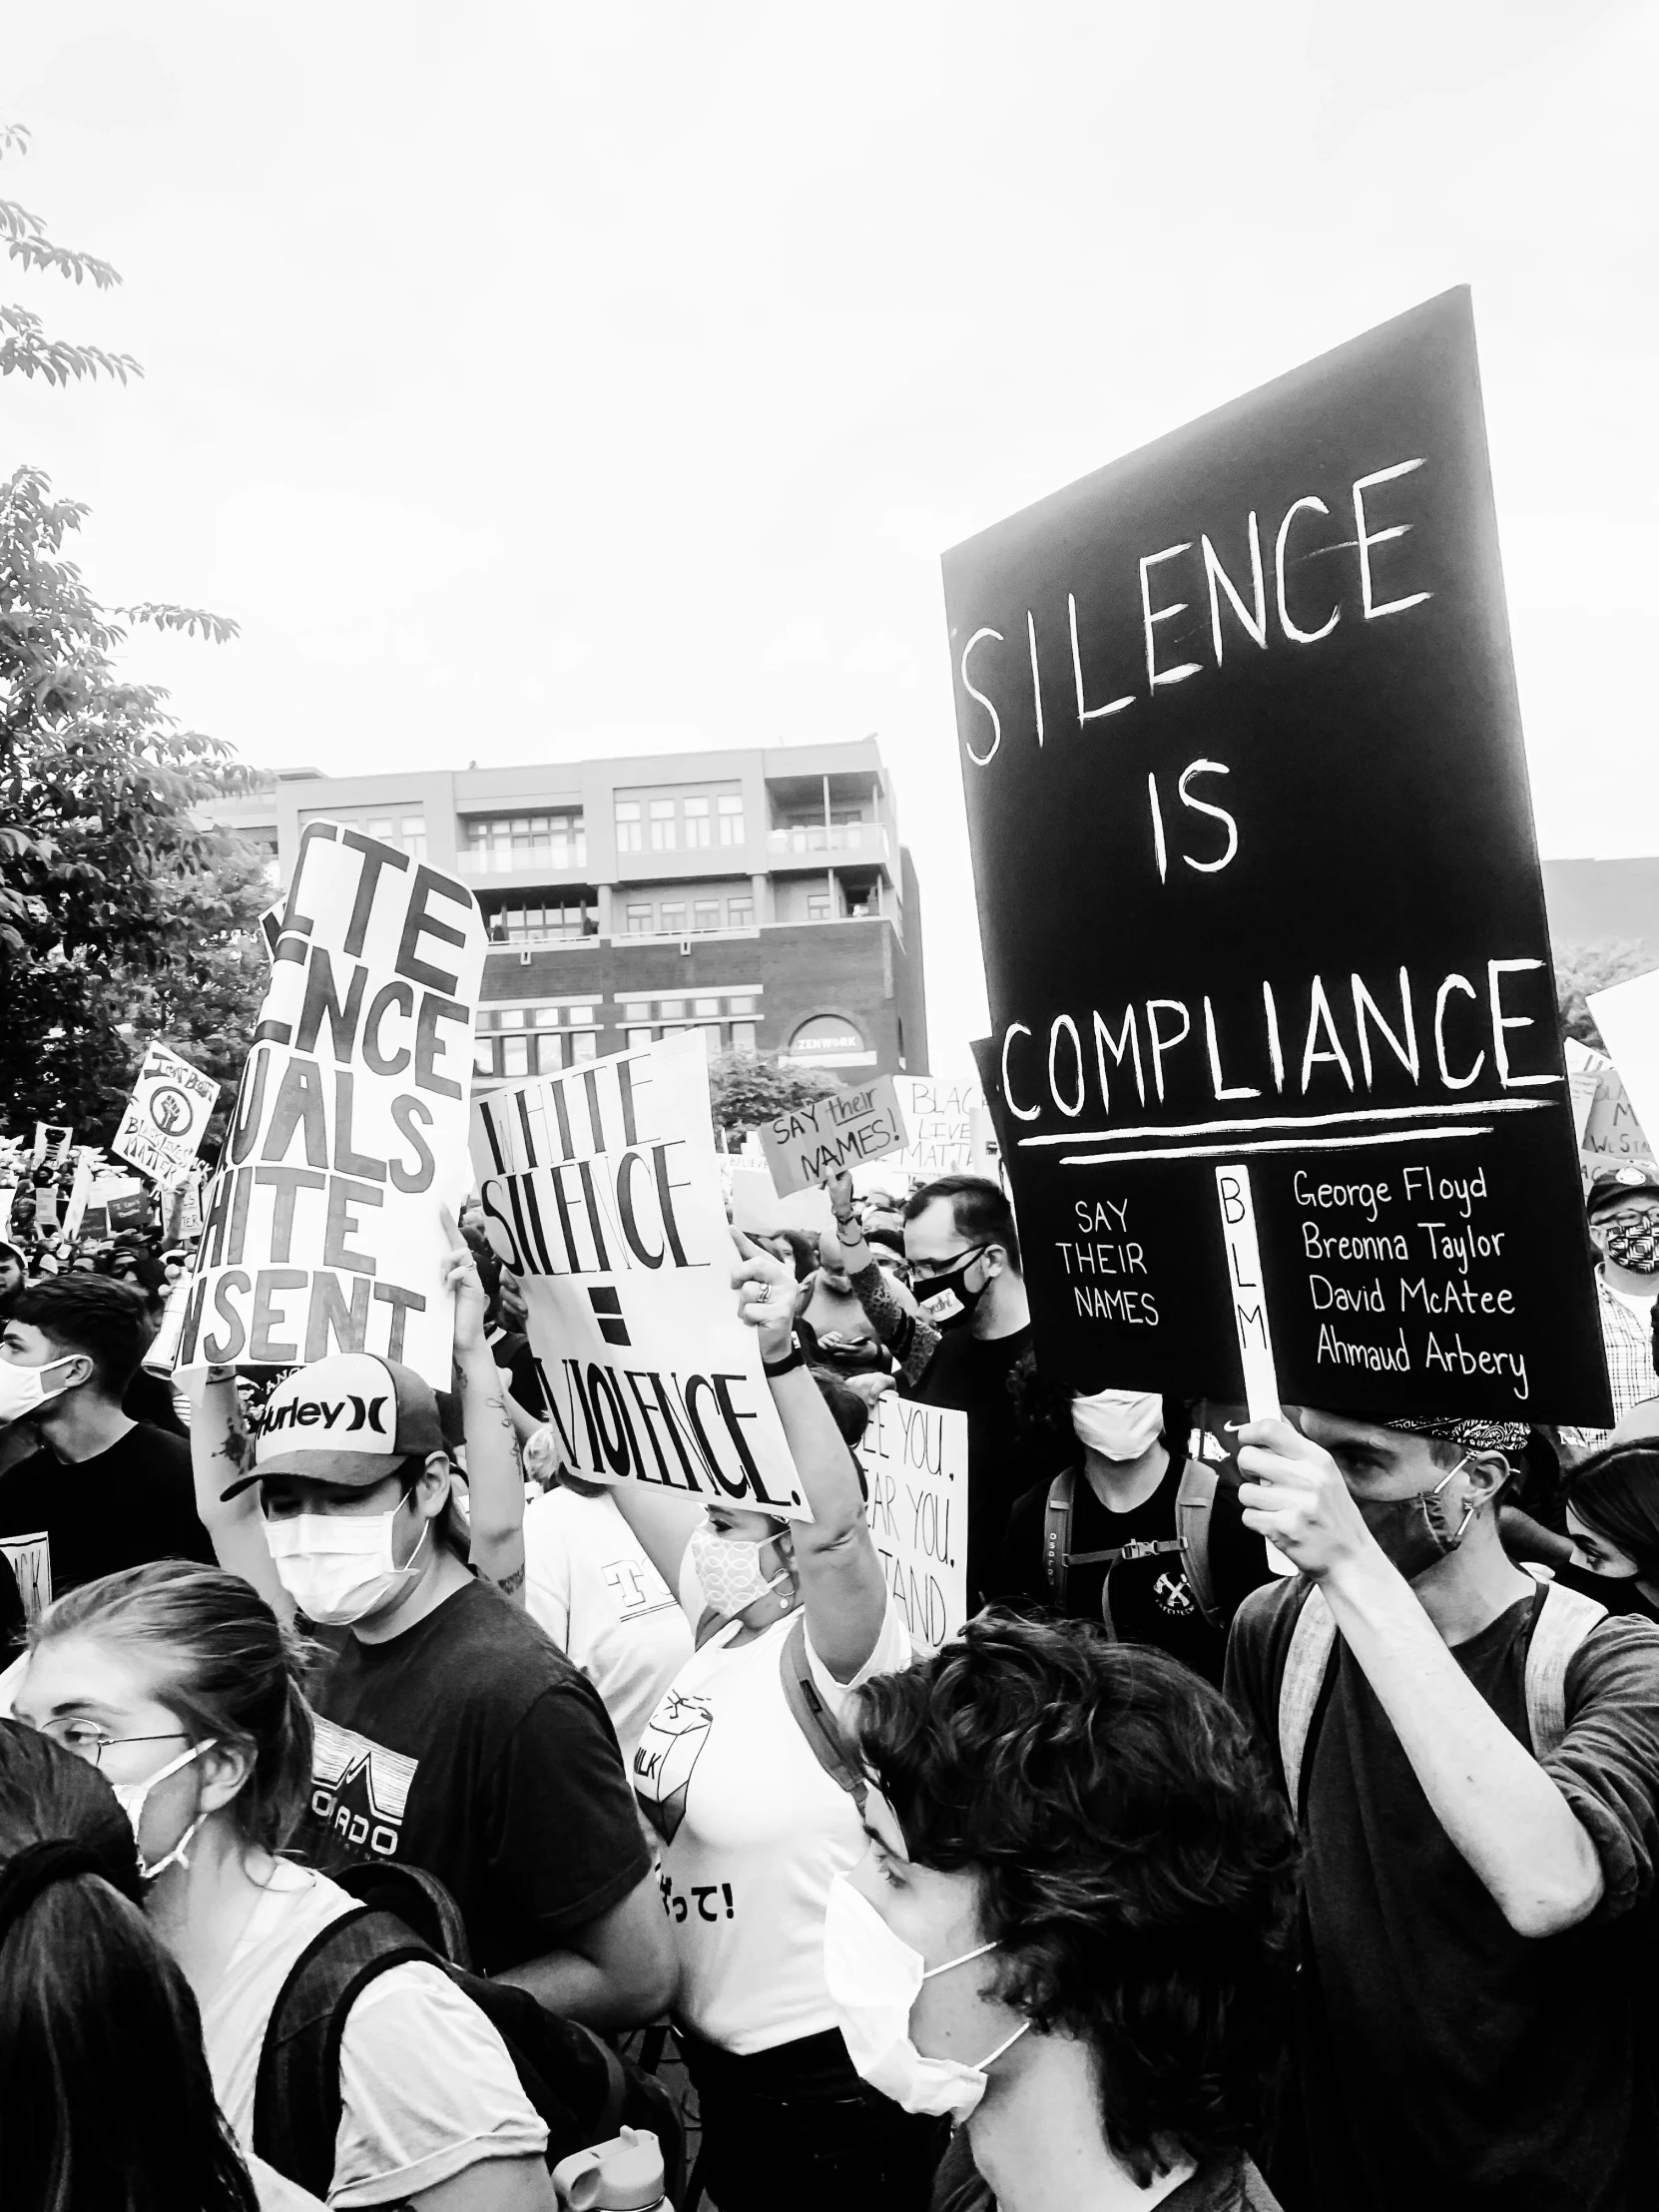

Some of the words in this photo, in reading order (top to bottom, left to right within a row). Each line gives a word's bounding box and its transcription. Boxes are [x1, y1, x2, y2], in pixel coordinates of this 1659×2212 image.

[961, 458, 1435, 766] SILENCE
[1147, 758, 1238, 884] IS
[1001, 958, 1565, 1120] COMPLIANCE
[479, 1054, 661, 1175] WHITE
[774, 1105, 819, 1144] SAY
[825, 1088, 877, 1123] their
[918, 1118, 970, 1140] LIVE
[123, 1137, 177, 1186] MATTER
[801, 1108, 899, 1181] NAMES!
[481, 1141, 710, 1277] SILENCE
[1075, 1198, 1128, 1234] SAY
[1294, 1170, 1391, 1222] George
[1403, 1166, 1486, 1218] Floyd
[1055, 1242, 1148, 1274] THEIR
[1303, 1221, 1408, 1261] Breonna
[1417, 1223, 1504, 1274] Taylor
[1074, 1286, 1159, 1326] NAMES
[1310, 1275, 1385, 1312] David
[1400, 1278, 1515, 1315] McAtee
[1318, 1324, 1410, 1372] Ahmaud
[1426, 1332, 1528, 1399] Arbery
[258, 1396, 345, 1439] Hurley
[533, 1357, 802, 1506] VIOLENCE.
